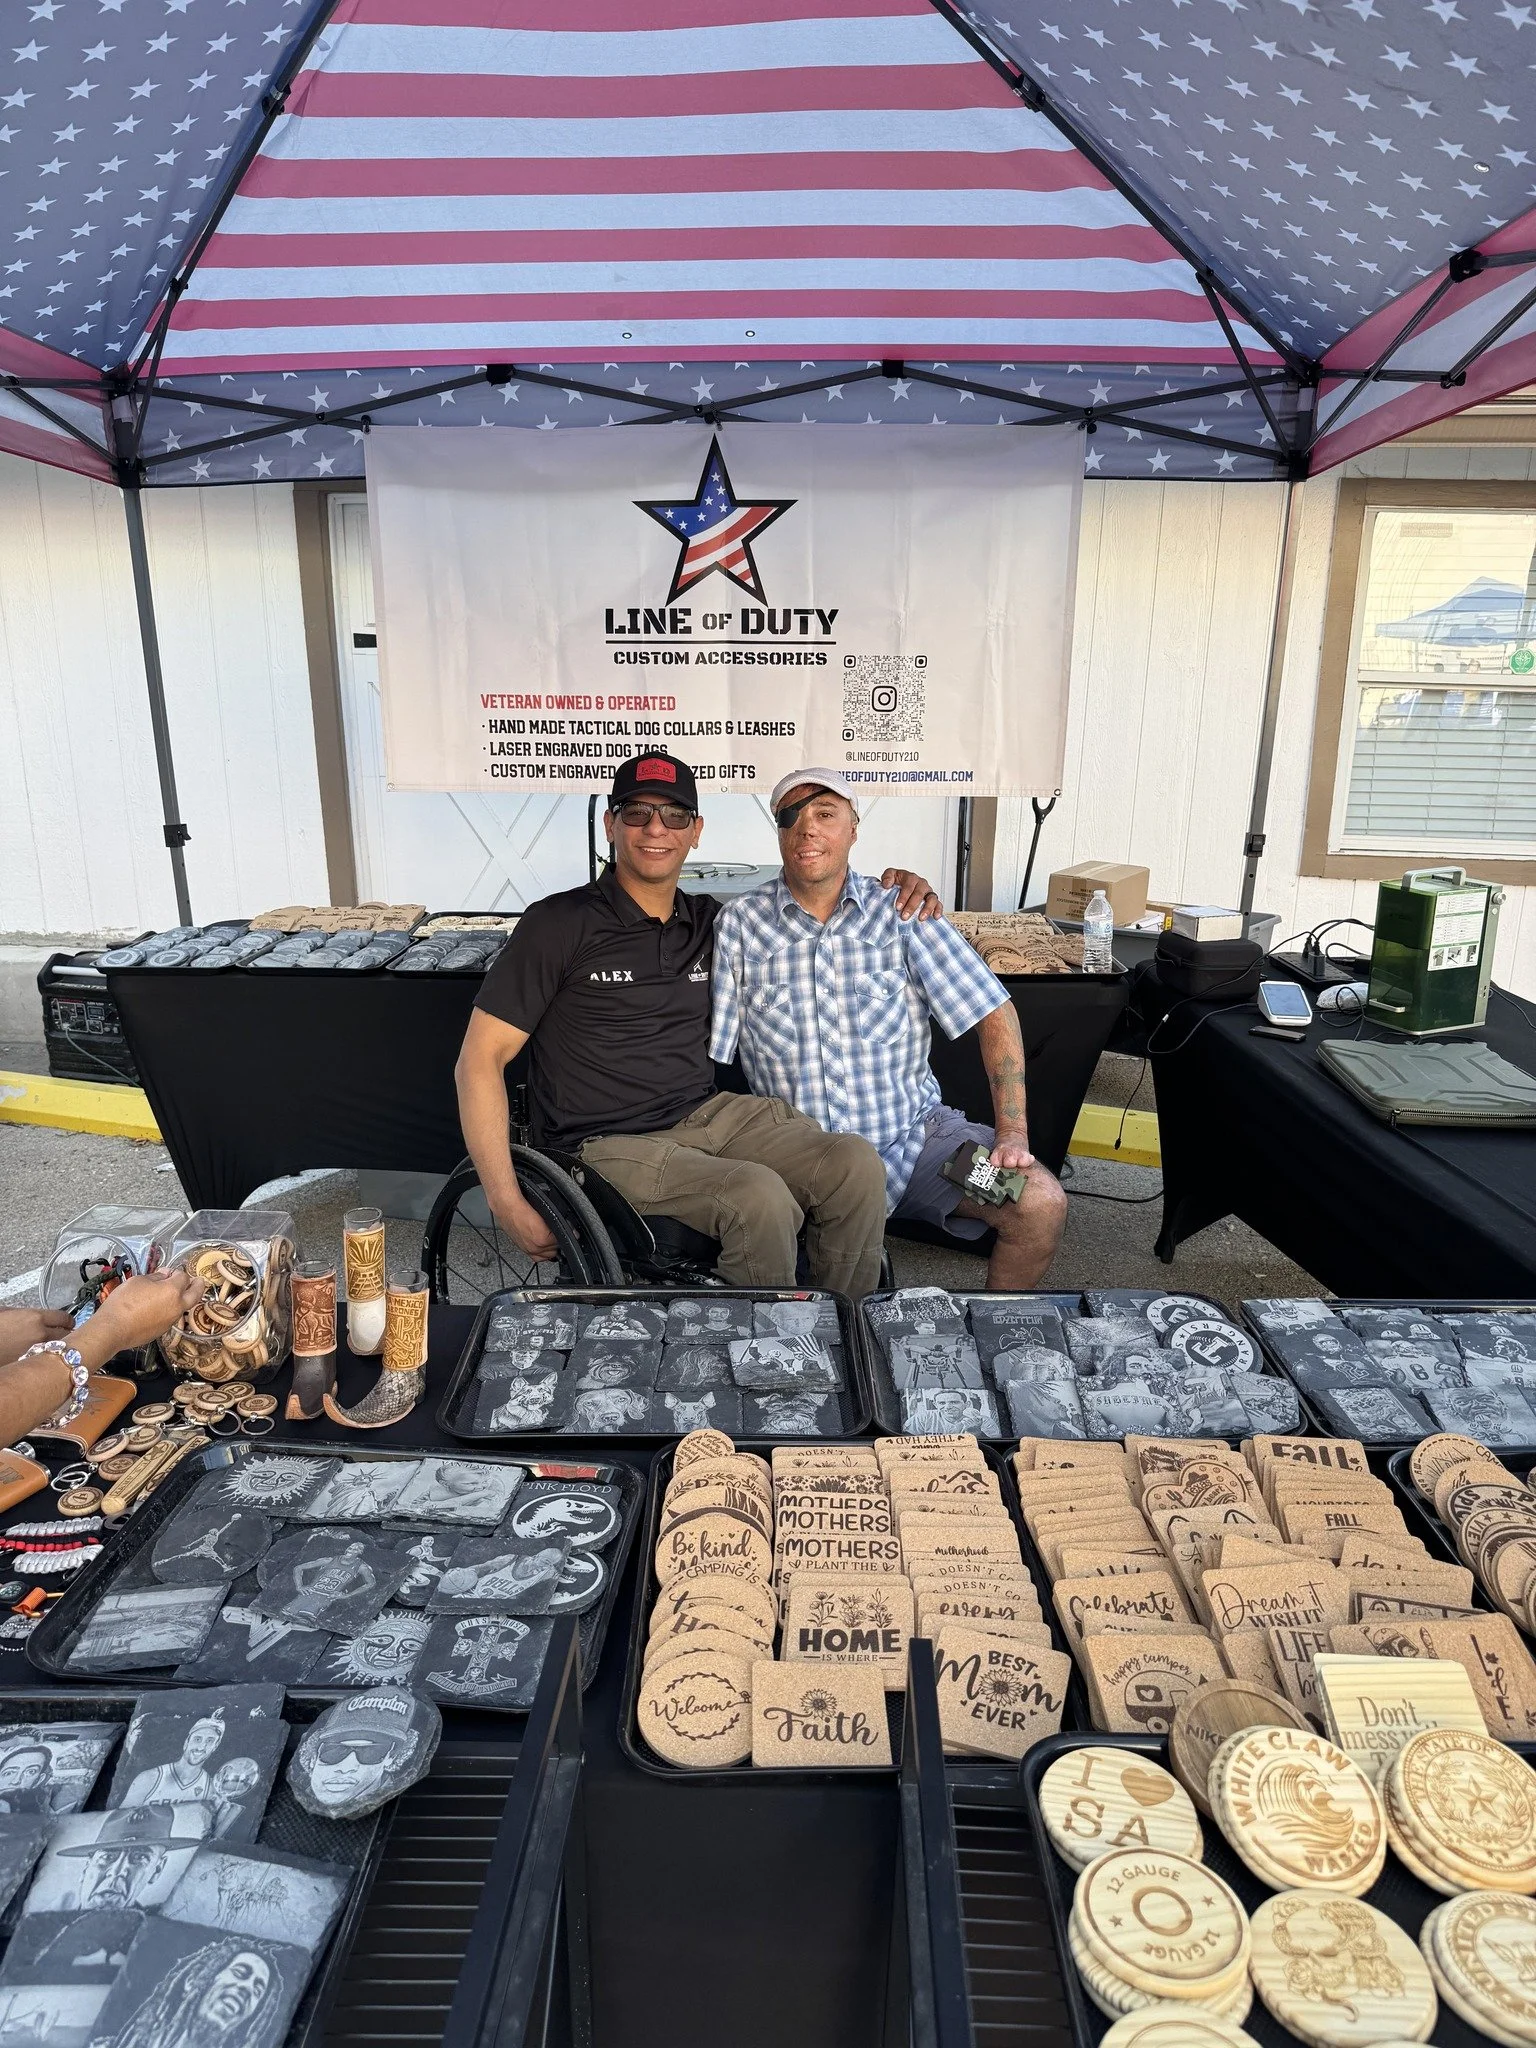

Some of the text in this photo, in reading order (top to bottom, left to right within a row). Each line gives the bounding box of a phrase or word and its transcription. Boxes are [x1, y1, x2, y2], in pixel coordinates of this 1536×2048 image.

[605, 608, 839, 635] LINE OF DUTY
[613, 651, 828, 666] CUSTOM ACCESSORIES
[480, 693, 676, 711] VETERAN OWNED & OPERATED
[488, 719, 796, 736] HAND MADE TACTICAL DOG COLLARS & LEASHES
[489, 741, 532, 756] LASER
[535, 742, 604, 757] ENGRAVED
[605, 743, 632, 758] DOG
[845, 751, 920, 763] @LINEOFDUTY210
[490, 763, 616, 779] CUSTOM ENGRAVED
[718, 764, 756, 779] GIFTS
[589, 970, 634, 982] ALEX
[967, 1161, 983, 1184] NAVY
[973, 1159, 992, 1188] FEDERA
[896, 1437, 925, 1446] HAD
[928, 1435, 955, 1445] THEY
[521, 1481, 612, 1495] PINK FLOYD
[779, 1510, 890, 1533] MOTHERS
[1324, 1513, 1363, 1527] FALL
[672, 1528, 752, 1560] Be kind
[785, 1538, 900, 1560] MOTHERS
[686, 1562, 745, 1579] CAMPING
[805, 1560, 878, 1572] PLANT THE
[944, 1580, 1001, 1593] DOESN'T
[1210, 1582, 1304, 1630] Dream
[1248, 1609, 1324, 1629] WISH IT
[799, 1628, 902, 1653] HOME
[821, 1653, 879, 1662] IS WHERE
[988, 1650, 1039, 1677] BEST
[1102, 1653, 1193, 1686] happy camper
[347, 1695, 408, 1716] Compton
[648, 1694, 738, 1722] Welcome
[970, 1701, 1026, 1731] EVER
[1357, 1696, 1421, 1728] Don't
[763, 1706, 879, 1746] Faith
[1343, 1728, 1401, 1751] mess
[1418, 1736, 1465, 1767] STATE
[1467, 1737, 1495, 1758] OF
[1230, 1731, 1353, 1828] WHITE CLAW
[1106, 1864, 1181, 1896] 12 GAUGE
[1143, 1942, 1206, 1963] GAUGE
